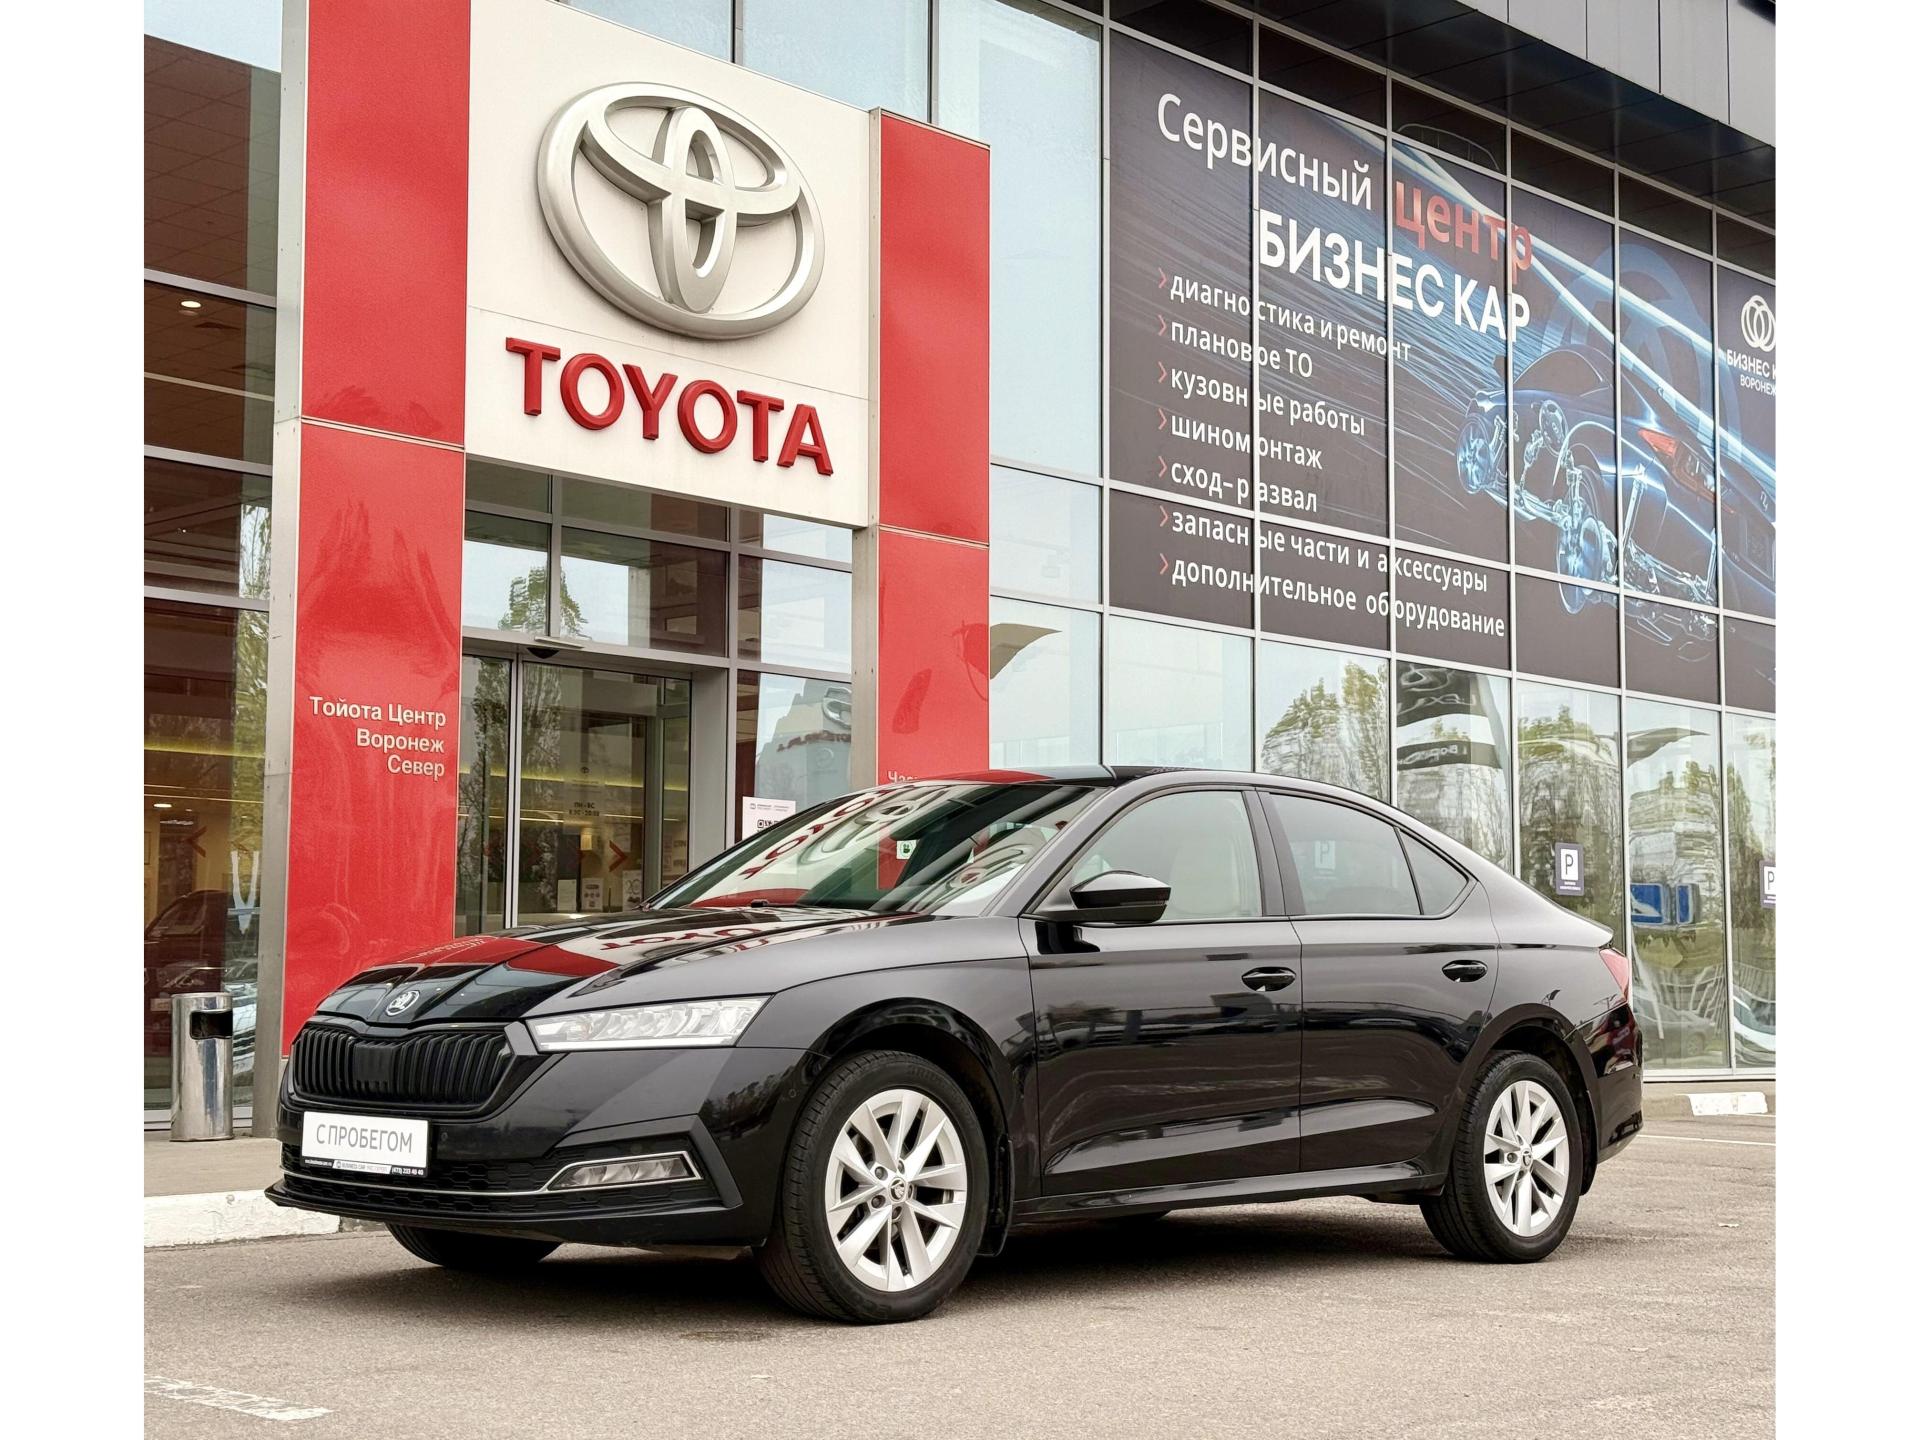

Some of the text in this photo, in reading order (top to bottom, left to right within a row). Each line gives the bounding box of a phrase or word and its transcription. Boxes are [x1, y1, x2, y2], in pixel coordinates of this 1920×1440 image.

[1157, 93, 1534, 285] Сервисный центр
[1259, 208, 1531, 343] БИЗНЕС КАР
[1170, 275, 1411, 362] диагностика и ремонт
[1171, 322, 1313, 378] плановое ТО
[1726, 349, 1770, 378] БИЗНЕС
[505, 336, 834, 476] TOYOTA
[1171, 368, 1365, 436] кузовные работы
[1171, 415, 1323, 470] шиномонтаж
[1172, 511, 1488, 595] запасные части и аксессуары
[1172, 559, 1505, 637] дополнительное оборудование
[309, 695, 447, 730] Тойота Центр
[356, 728, 445, 753] Воронеж
[387, 754, 445, 781] Север
[316, 1124, 413, 1154] С ПРОБЕГОМ
